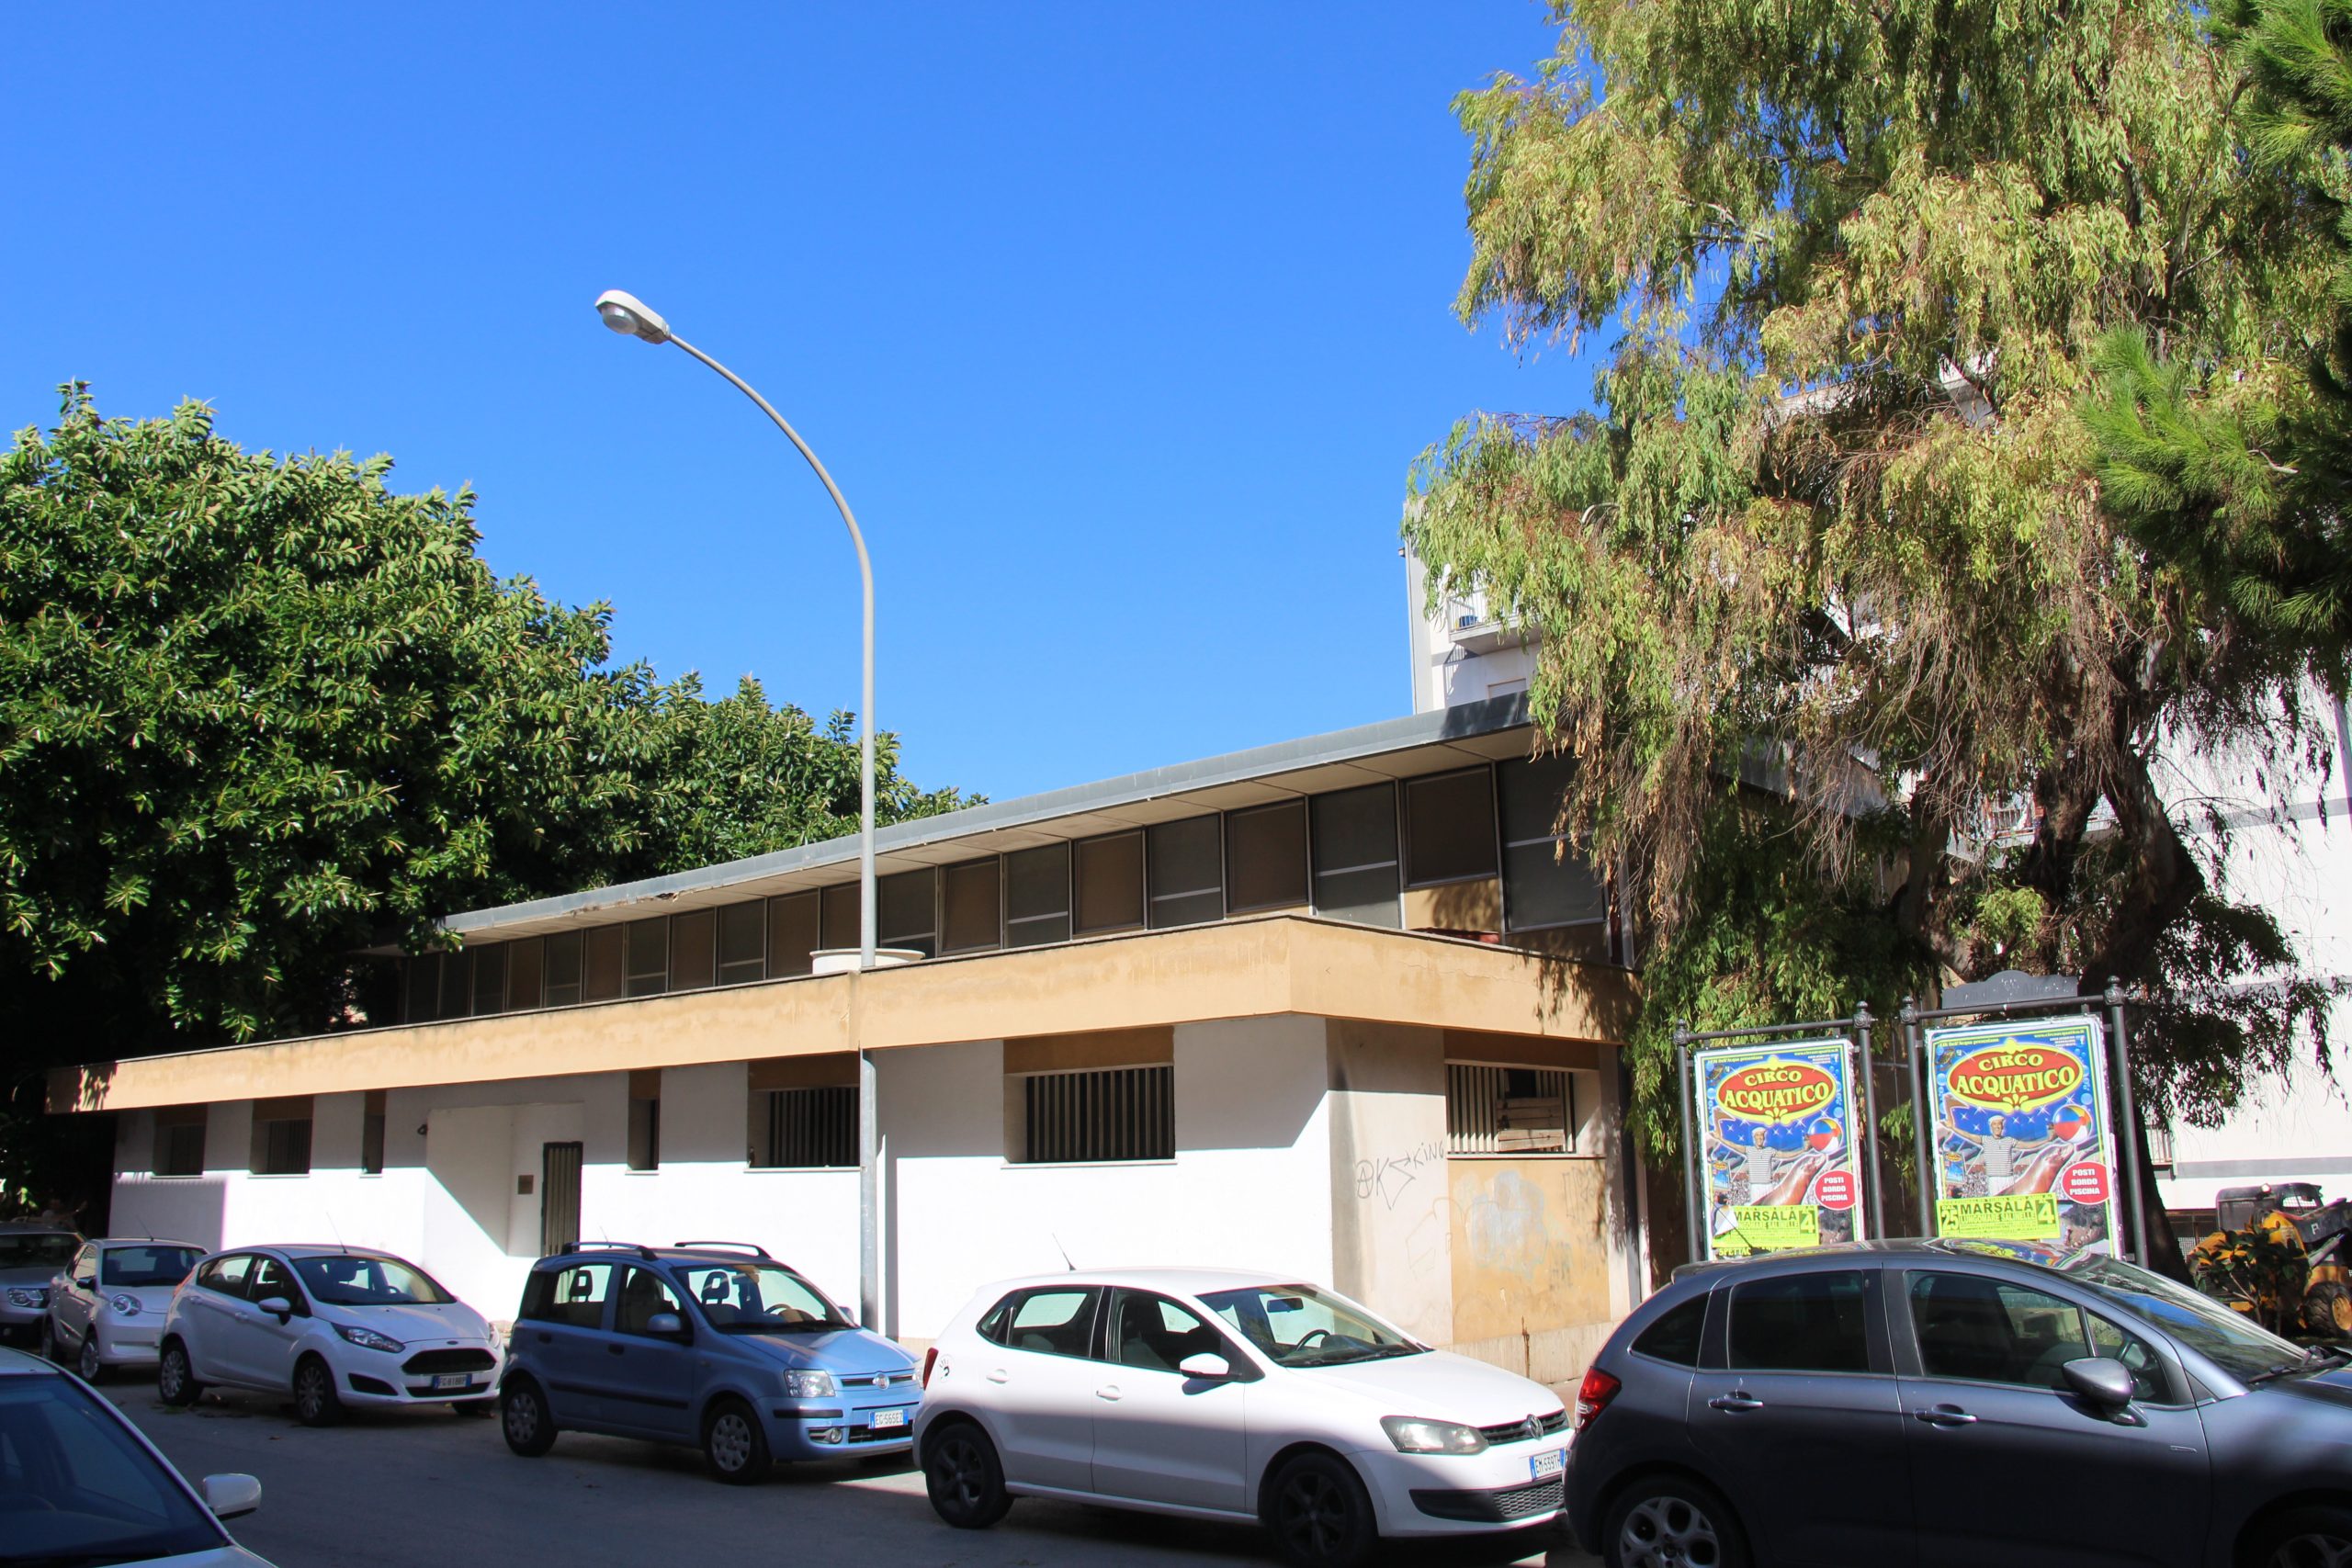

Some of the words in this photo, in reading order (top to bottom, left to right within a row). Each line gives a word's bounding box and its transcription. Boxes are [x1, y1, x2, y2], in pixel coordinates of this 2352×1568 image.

[1978, 1054, 2043, 1071] CIRCO
[1744, 1070, 1803, 1087] CIRCO
[1956, 1066, 2075, 1098] ACQUATICO
[1724, 1081, 1829, 1111] ACQUATICO
[2072, 1168, 2096, 1177] POSTI
[2071, 1178, 2098, 1186] BORDO
[2069, 1188, 2100, 1196] PISCINA
[1960, 1200, 2033, 1214] MARSALA
[2038, 1201, 2056, 1224] 4
[1734, 1211, 1797, 1222] MARSALA
[1800, 1210, 1816, 1234] 4
[1941, 1210, 1959, 1231] 25
